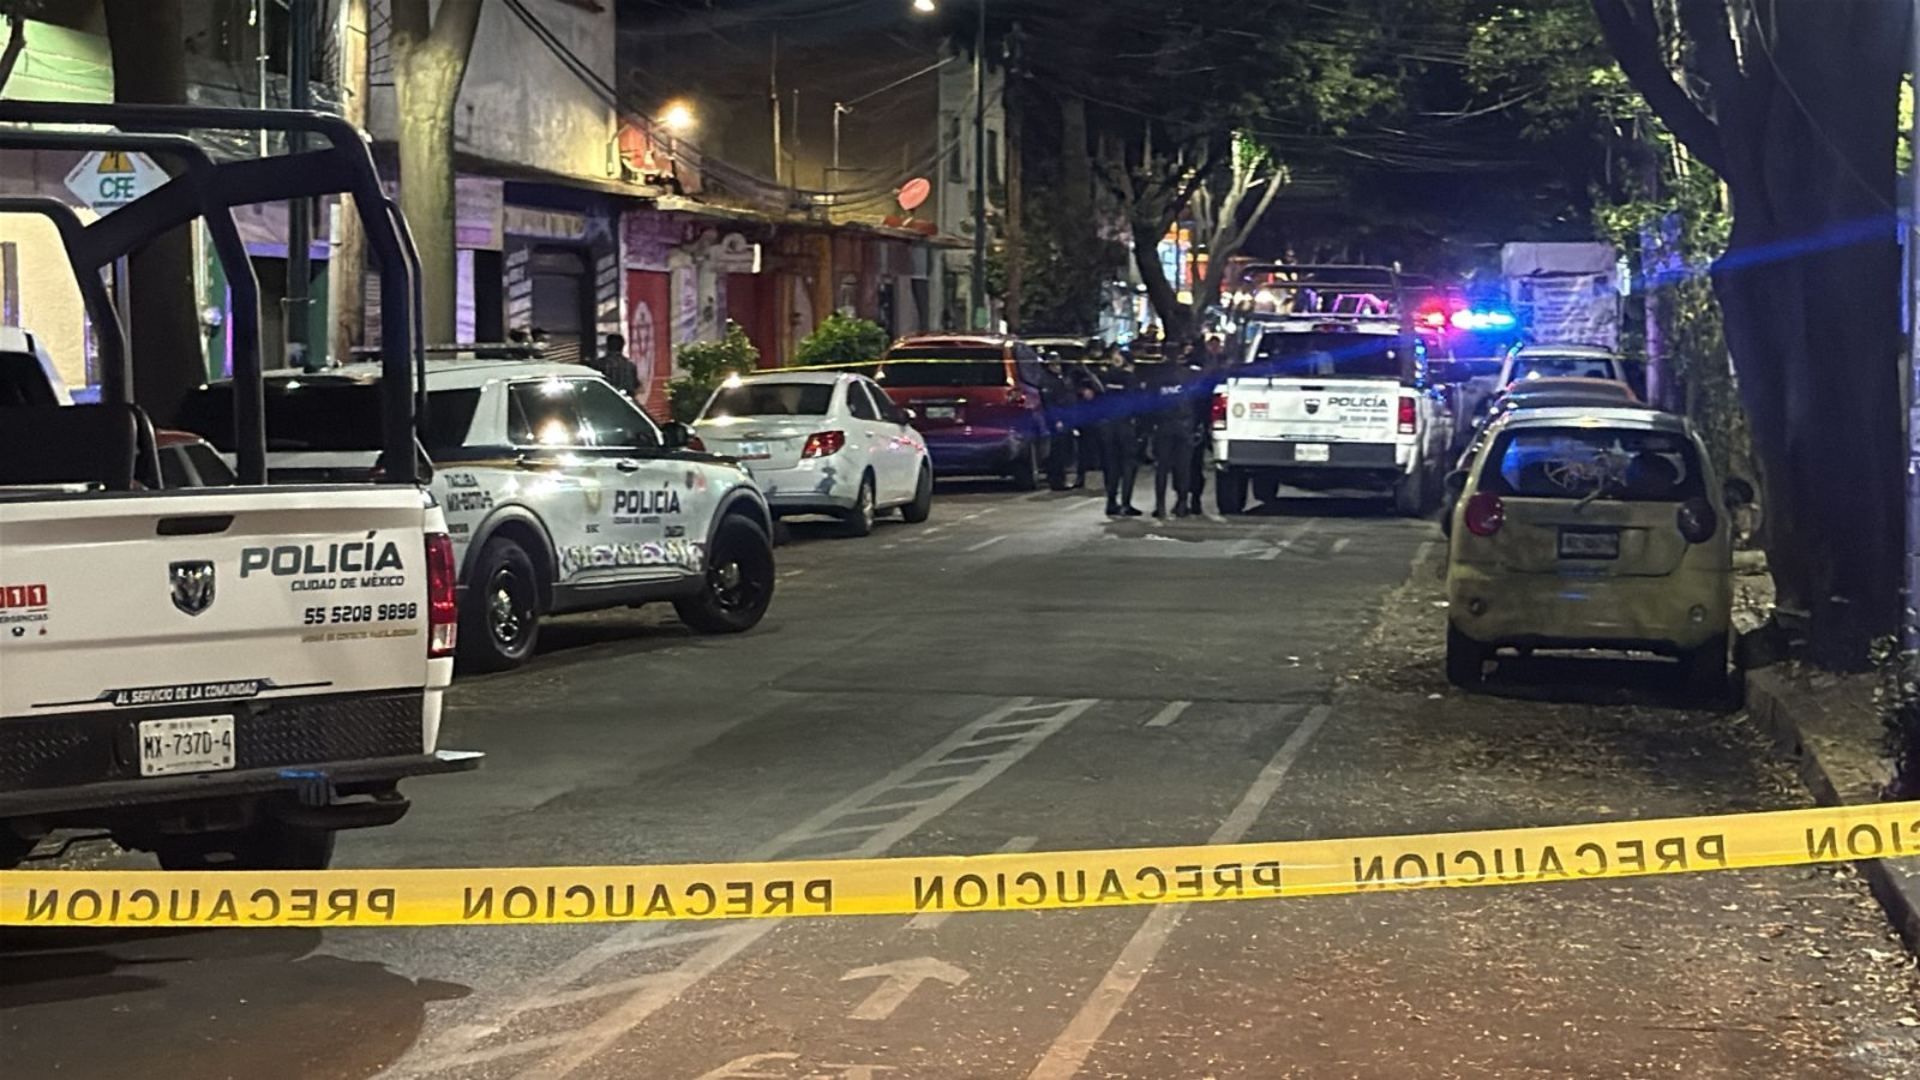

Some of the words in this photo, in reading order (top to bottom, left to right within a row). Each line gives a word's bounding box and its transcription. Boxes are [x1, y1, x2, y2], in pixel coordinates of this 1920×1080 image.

[99, 176, 135, 199] CFE
[1327, 395, 1389, 408] POLICÍA
[613, 481, 681, 514] POLICÍA
[240, 530, 404, 578] POLICÍA
[291, 578, 336, 592] CIUDAD
[340, 577, 356, 589] DE
[360, 572, 405, 588] MÉXICO
[0, 587, 42, 605] 11
[304, 607, 326, 625] 55
[330, 605, 372, 624] 5208
[377, 602, 418, 621] 9898
[115, 692, 129, 704] AL
[131, 687, 174, 703] SERVICIO
[175, 687, 187, 699] DE
[190, 686, 202, 698] LA
[204, 681, 259, 698] COMUNIDAD
[143, 730, 231, 760] MX-737D-4
